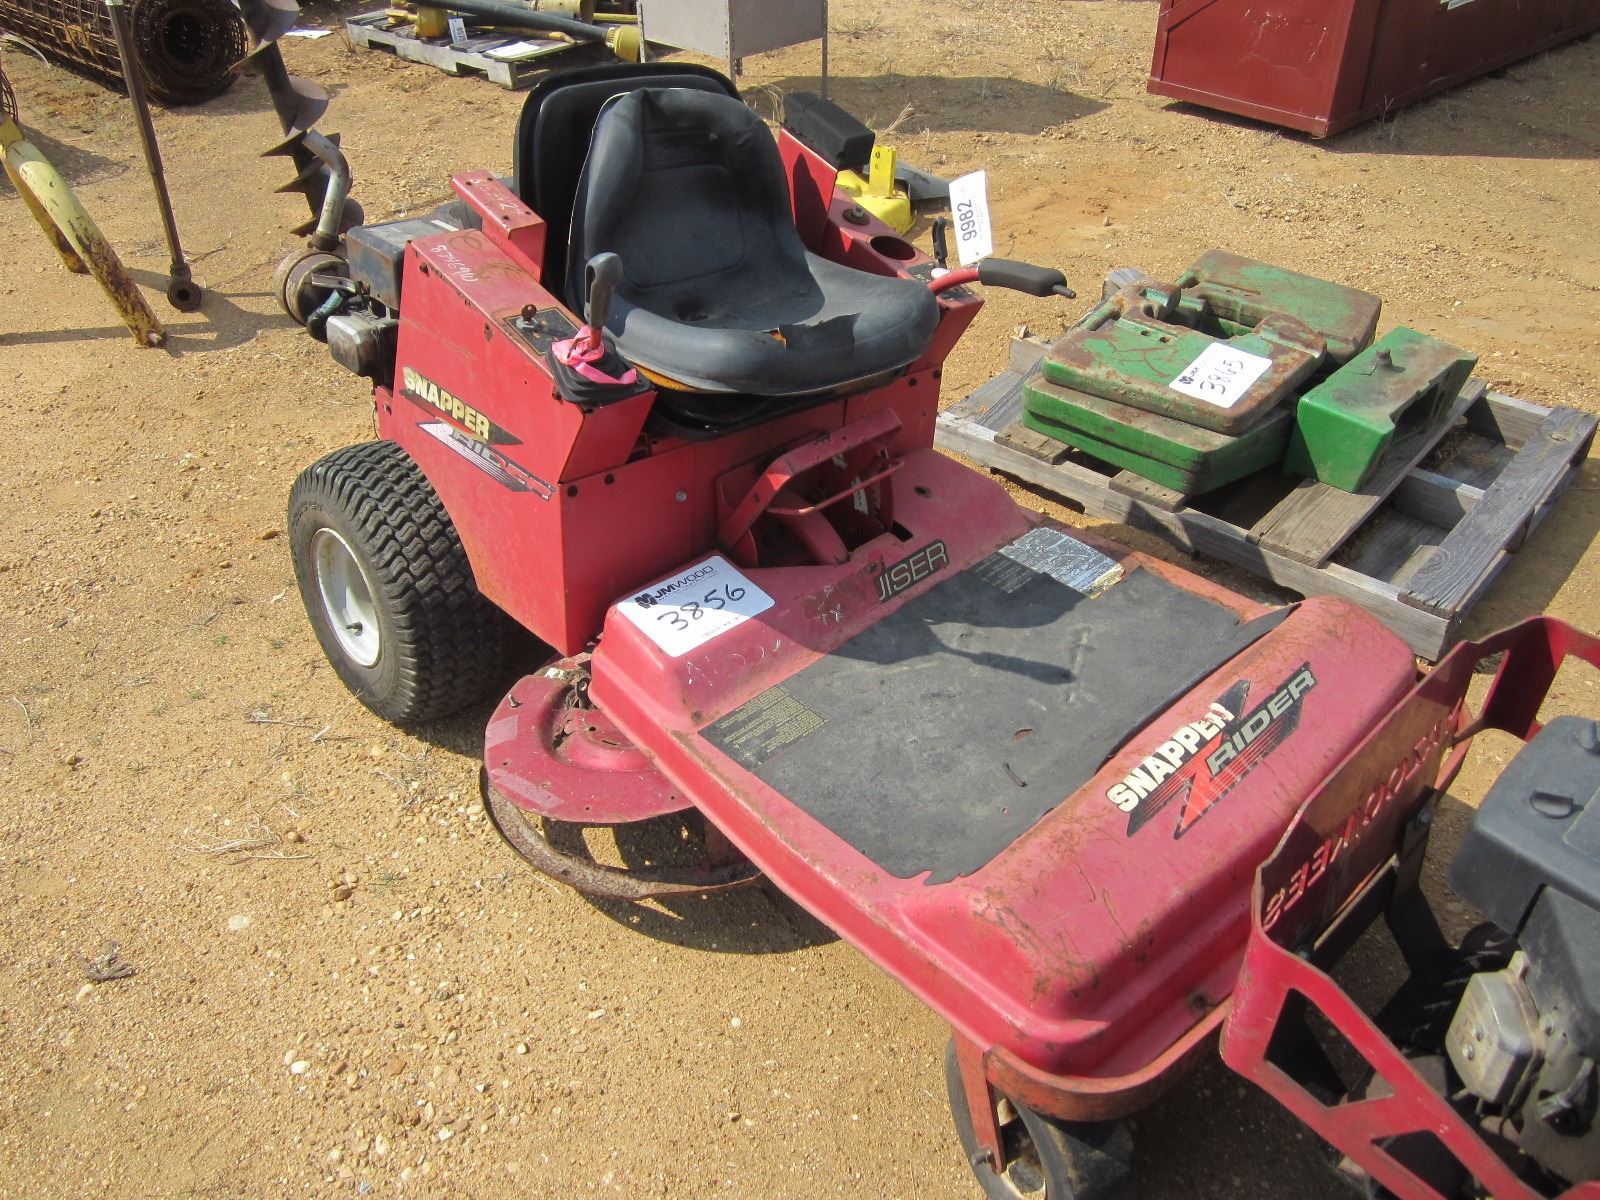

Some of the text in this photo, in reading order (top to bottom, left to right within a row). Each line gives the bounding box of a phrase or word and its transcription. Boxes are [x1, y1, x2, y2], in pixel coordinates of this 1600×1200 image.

[957, 199, 977, 241] 9982
[402, 366, 489, 441] SNAPPER
[657, 584, 746, 630] 3856
[1206, 670, 1316, 776] RIDER
